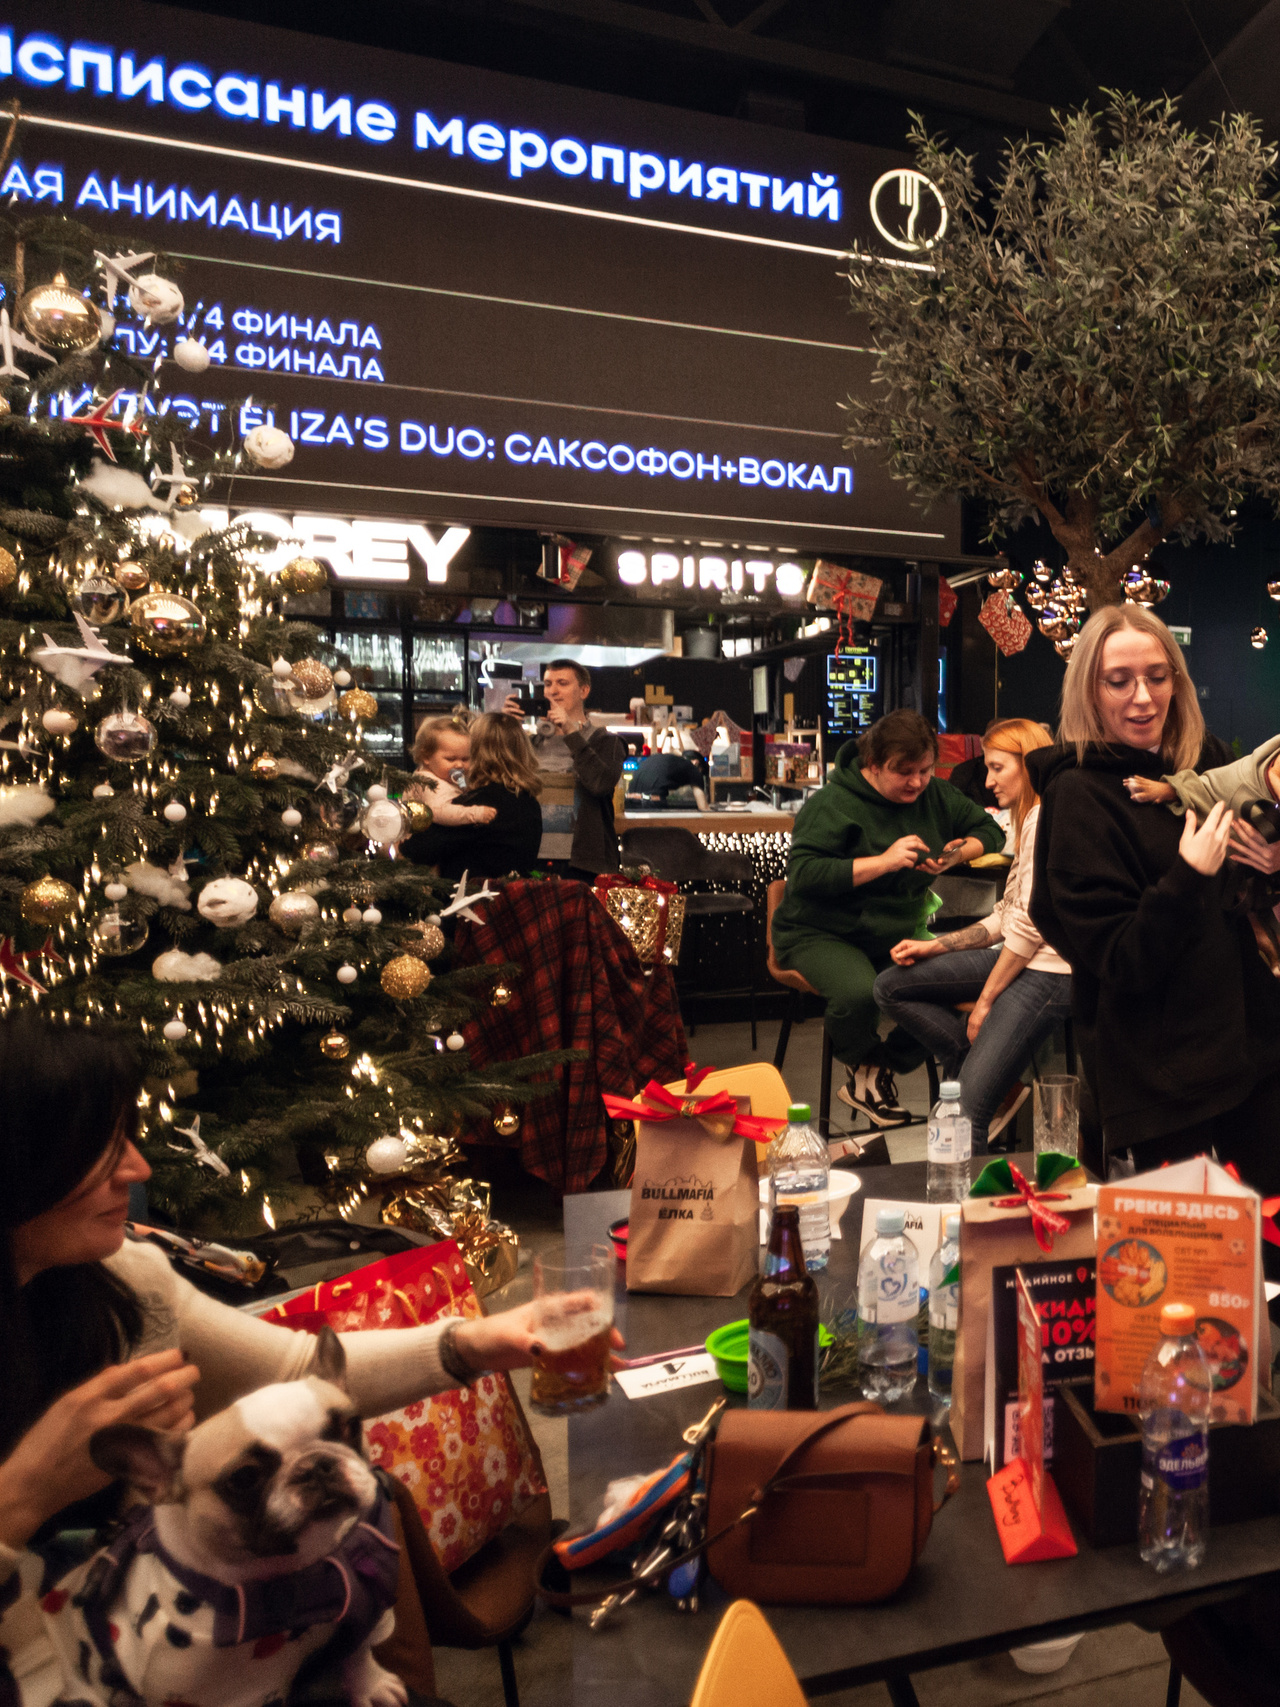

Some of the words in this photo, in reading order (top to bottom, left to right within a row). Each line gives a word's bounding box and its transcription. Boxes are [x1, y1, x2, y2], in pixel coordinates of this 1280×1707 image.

[415, 112, 840, 221] мероприятий
[77, 176, 342, 244] АНИМАЦИЯ
[232, 309, 382, 350] ФИНАЛА
[235, 342, 385, 382] ФИНАЛА
[400, 421, 496, 459] DUO:
[504, 433, 853, 493] САКСОФОН+ВОКАЛ
[617, 550, 804, 595] SPIRITS
[641, 1187, 714, 1201] BULLMAFIA
[1113, 1197, 1173, 1216] ГРЕКИ
[1175, 1201, 1240, 1221] ЗДЕСЬ
[1006, 1273, 1074, 1289] МДИЙНОЕ
[1035, 1297, 1096, 1320] КИДК
